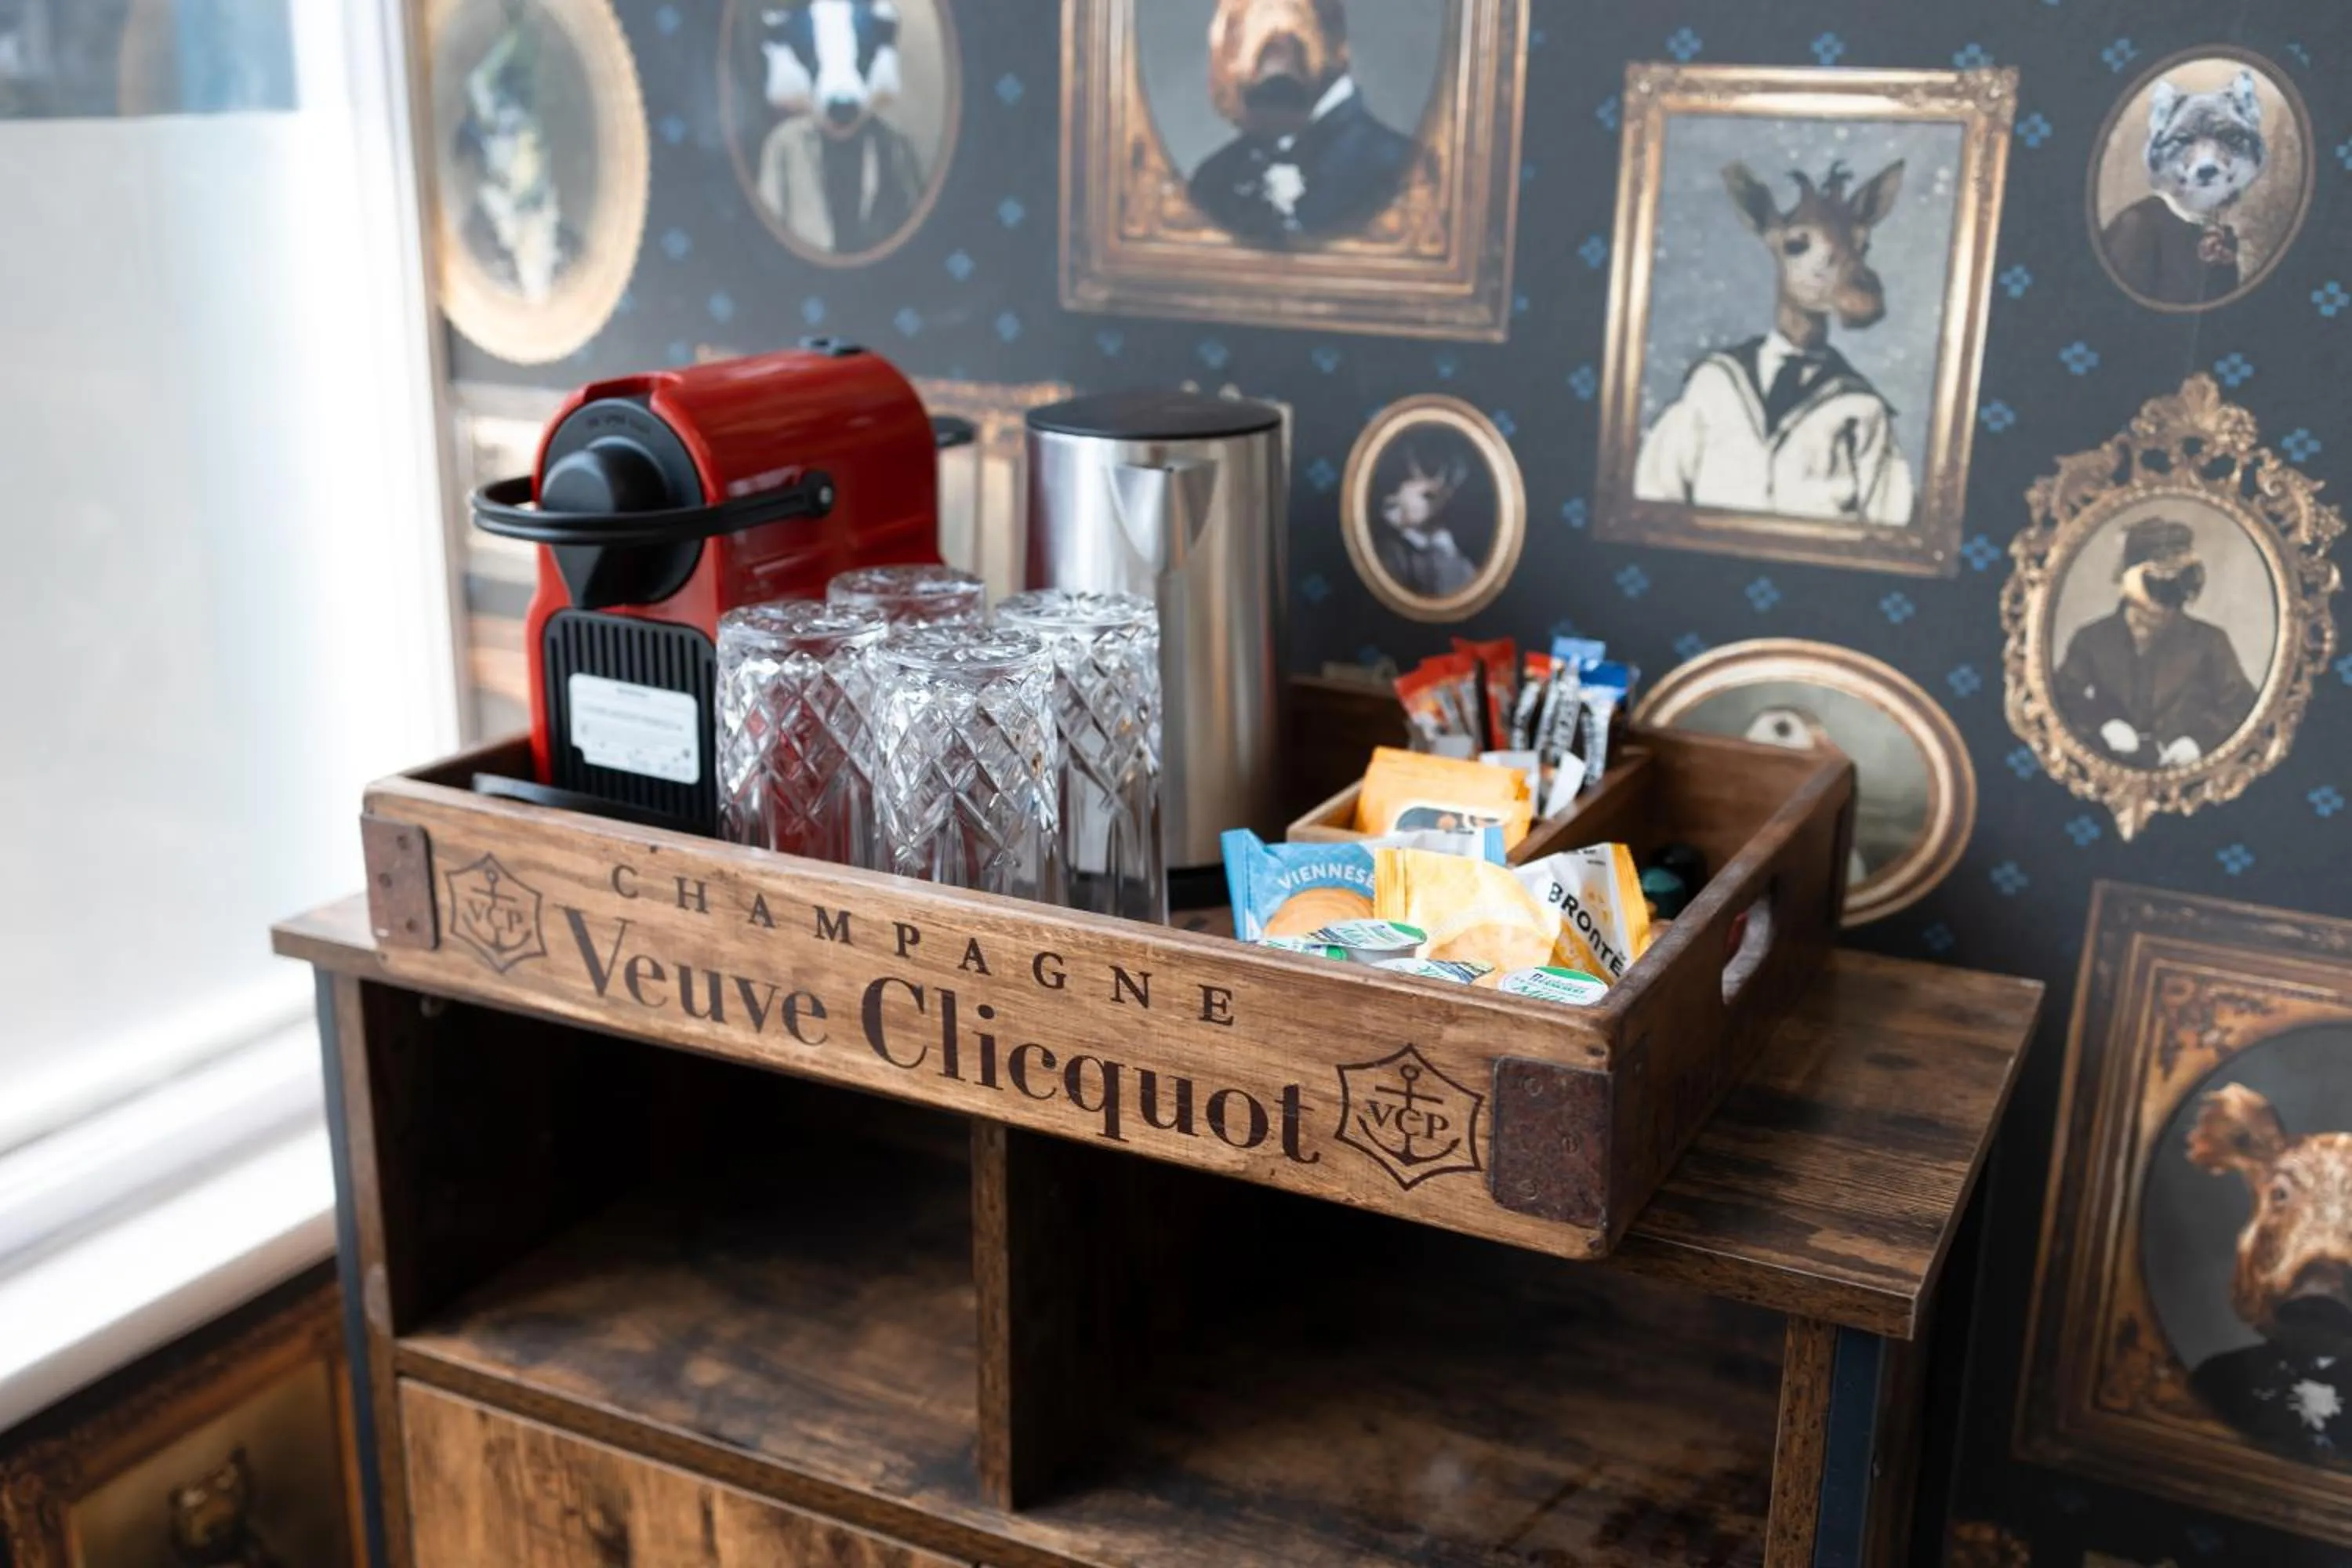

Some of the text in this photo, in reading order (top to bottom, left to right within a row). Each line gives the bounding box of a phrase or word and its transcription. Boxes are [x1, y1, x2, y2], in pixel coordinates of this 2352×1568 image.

[612, 864, 1234, 1025] CHAMPAGNE
[554, 903, 1320, 1165] Veuve Clicquot
[1367, 1100, 1450, 1140] VCP
